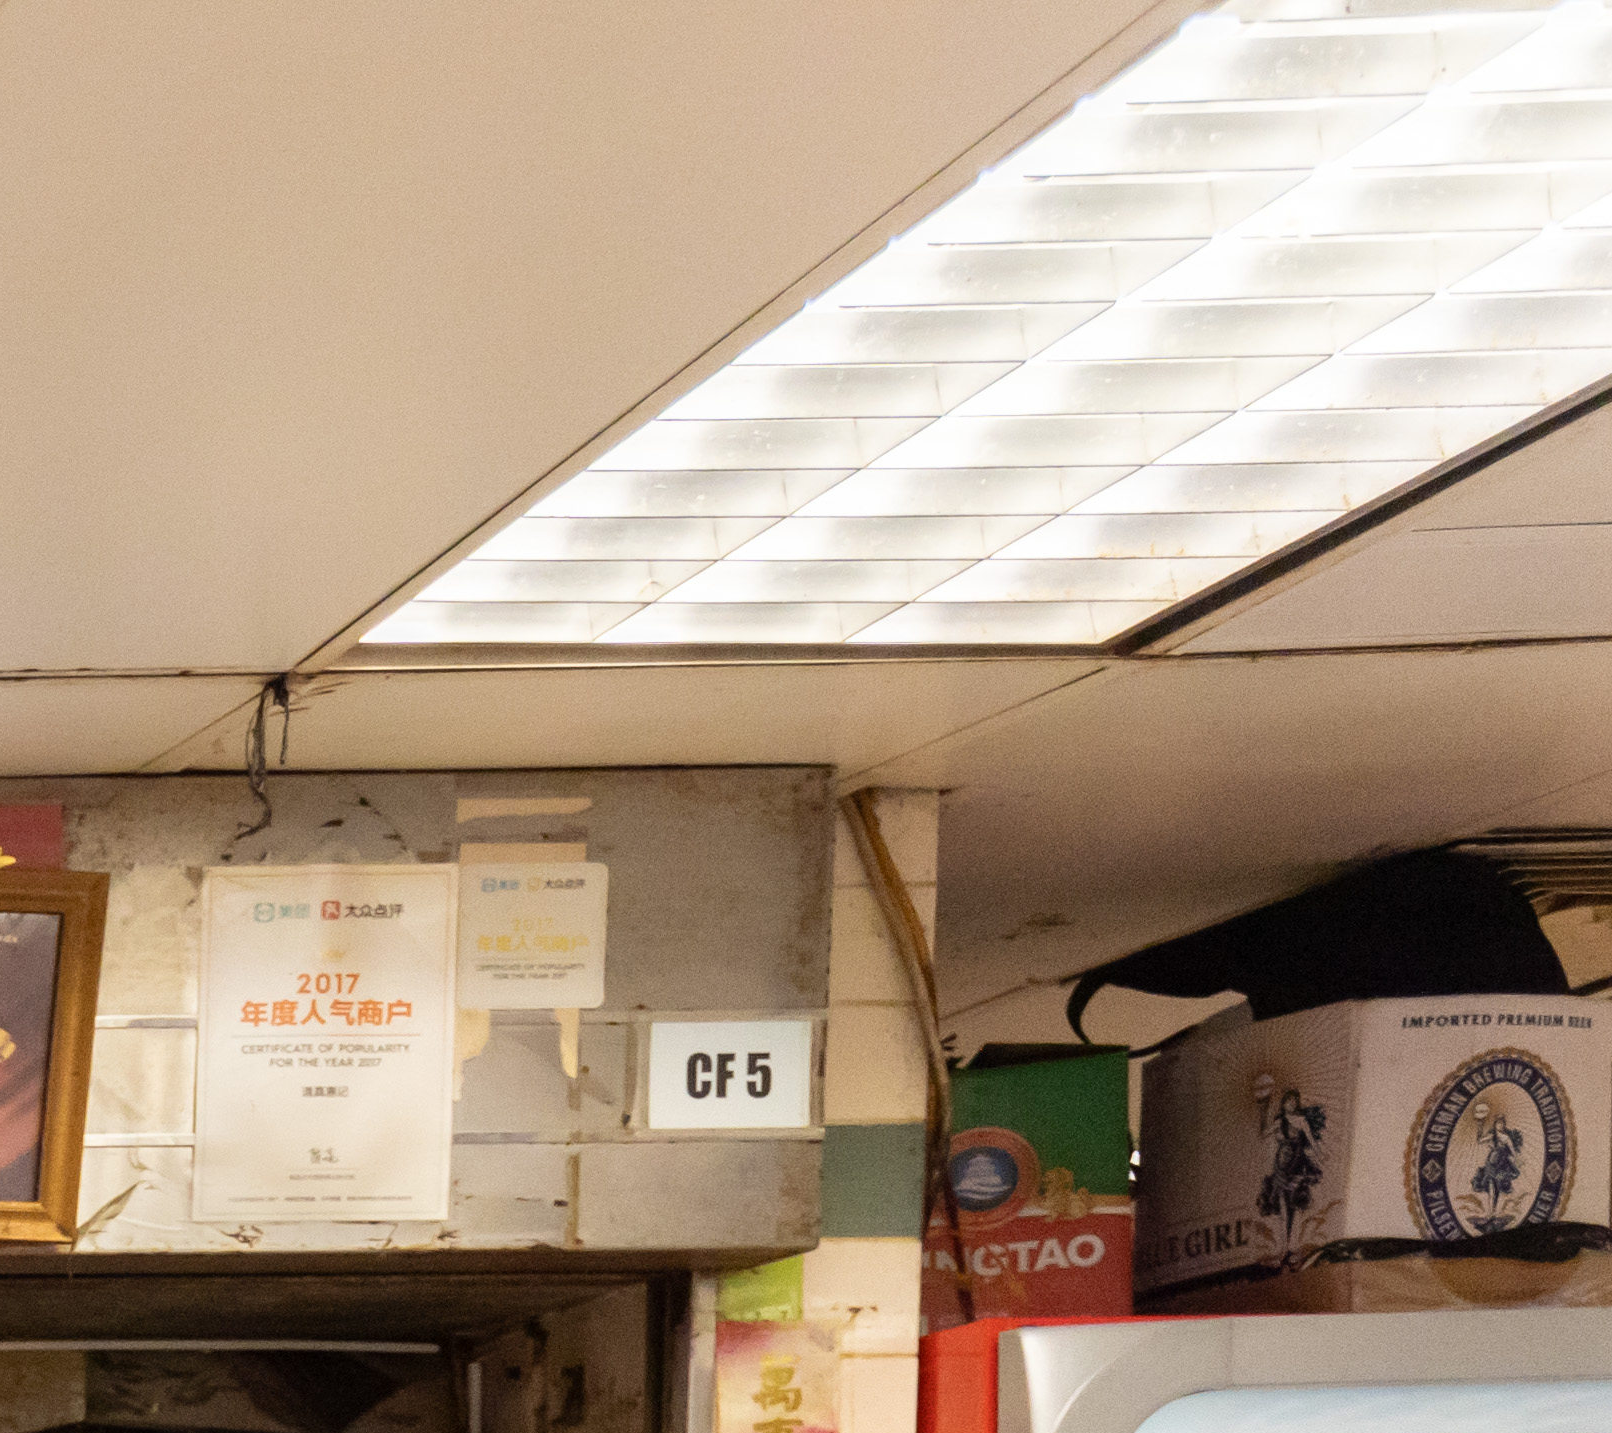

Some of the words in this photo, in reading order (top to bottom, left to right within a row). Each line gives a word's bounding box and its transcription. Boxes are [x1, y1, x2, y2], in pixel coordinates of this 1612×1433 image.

[297, 973, 360, 994] 2017
[241, 1001, 412, 1027] 年度人气商户
[685, 1051, 731, 1100] CF
[743, 1052, 773, 1099] 5
